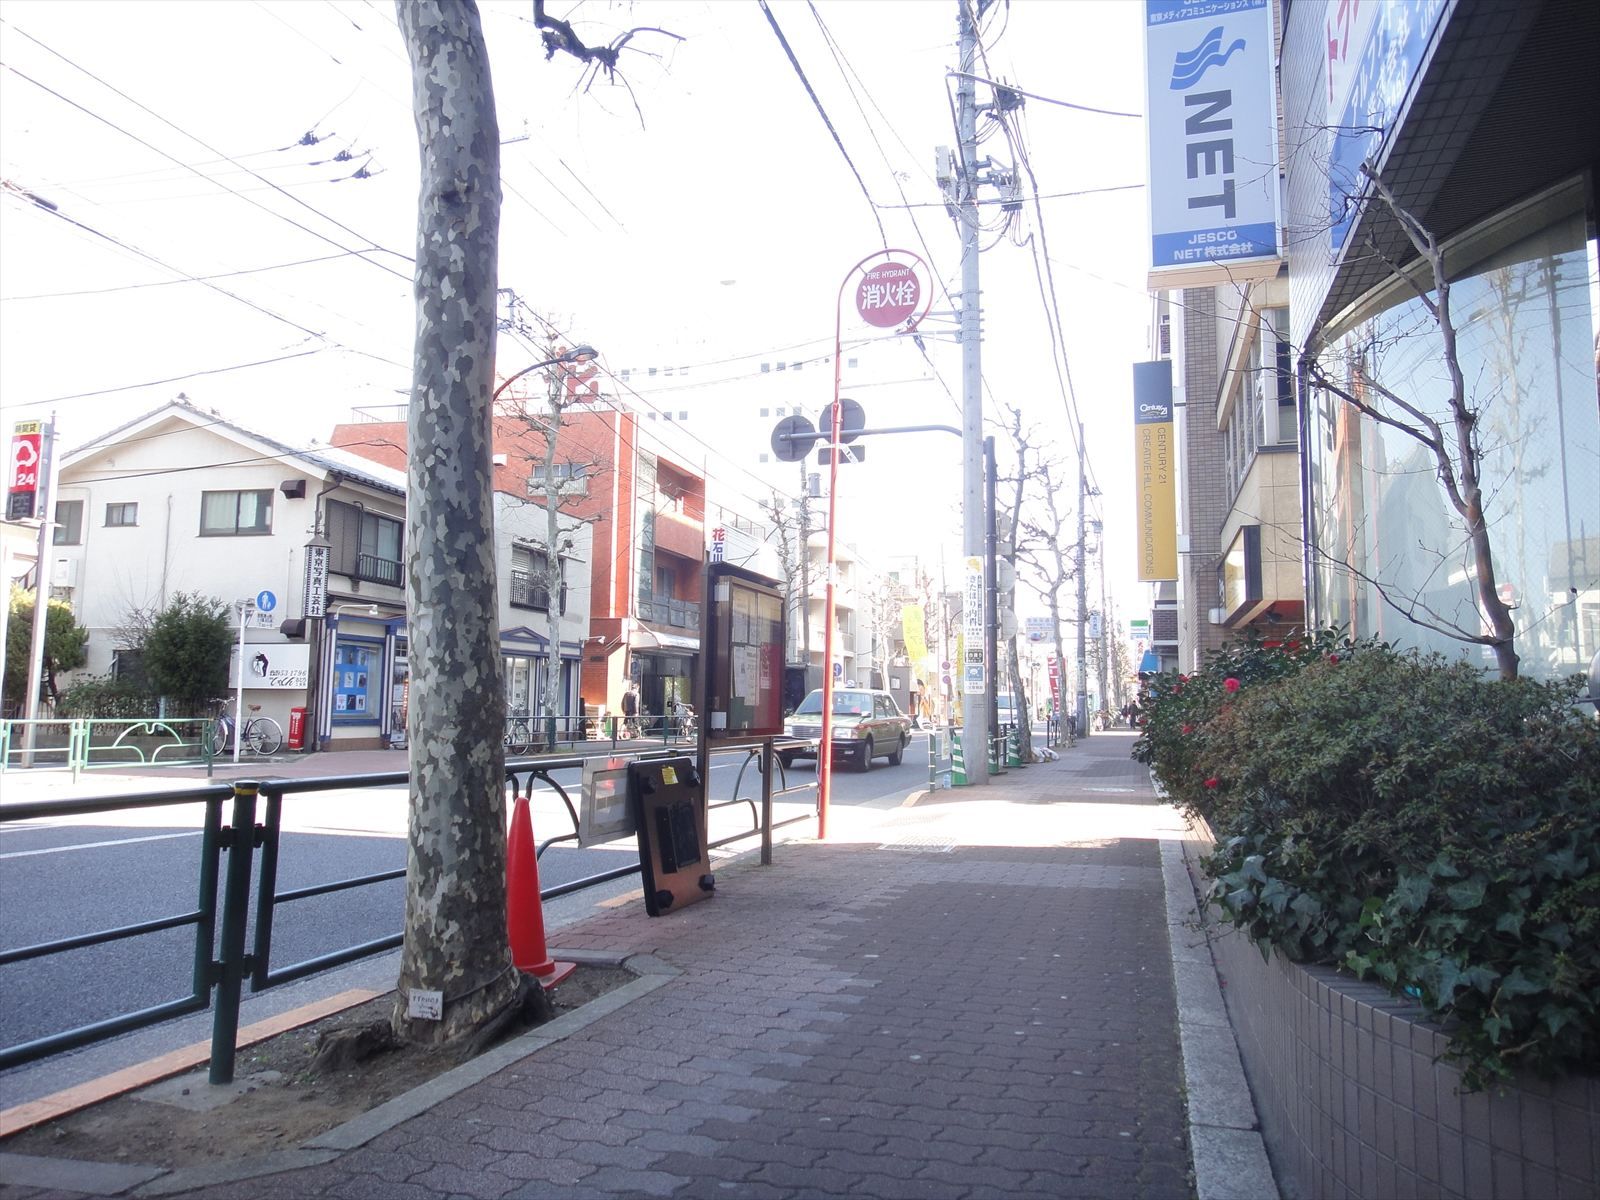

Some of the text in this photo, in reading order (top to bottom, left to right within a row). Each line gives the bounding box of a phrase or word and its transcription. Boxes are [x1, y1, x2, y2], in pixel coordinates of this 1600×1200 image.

[1184, 89, 1236, 219] NET
[1174, 241, 1253, 260] NET 株式会社
[1188, 230, 1238, 245] JESCO
[866, 268, 910, 280] FIRE HYDRANT
[861, 279, 916, 310] 消火栓
[1142, 428, 1152, 471] CREATIVE
[1157, 427, 1167, 472] CENTURY
[17, 473, 35, 486] 24
[1143, 493, 1154, 576] COMMUNICATIONS
[311, 548, 324, 615] 東京写真工芸社
